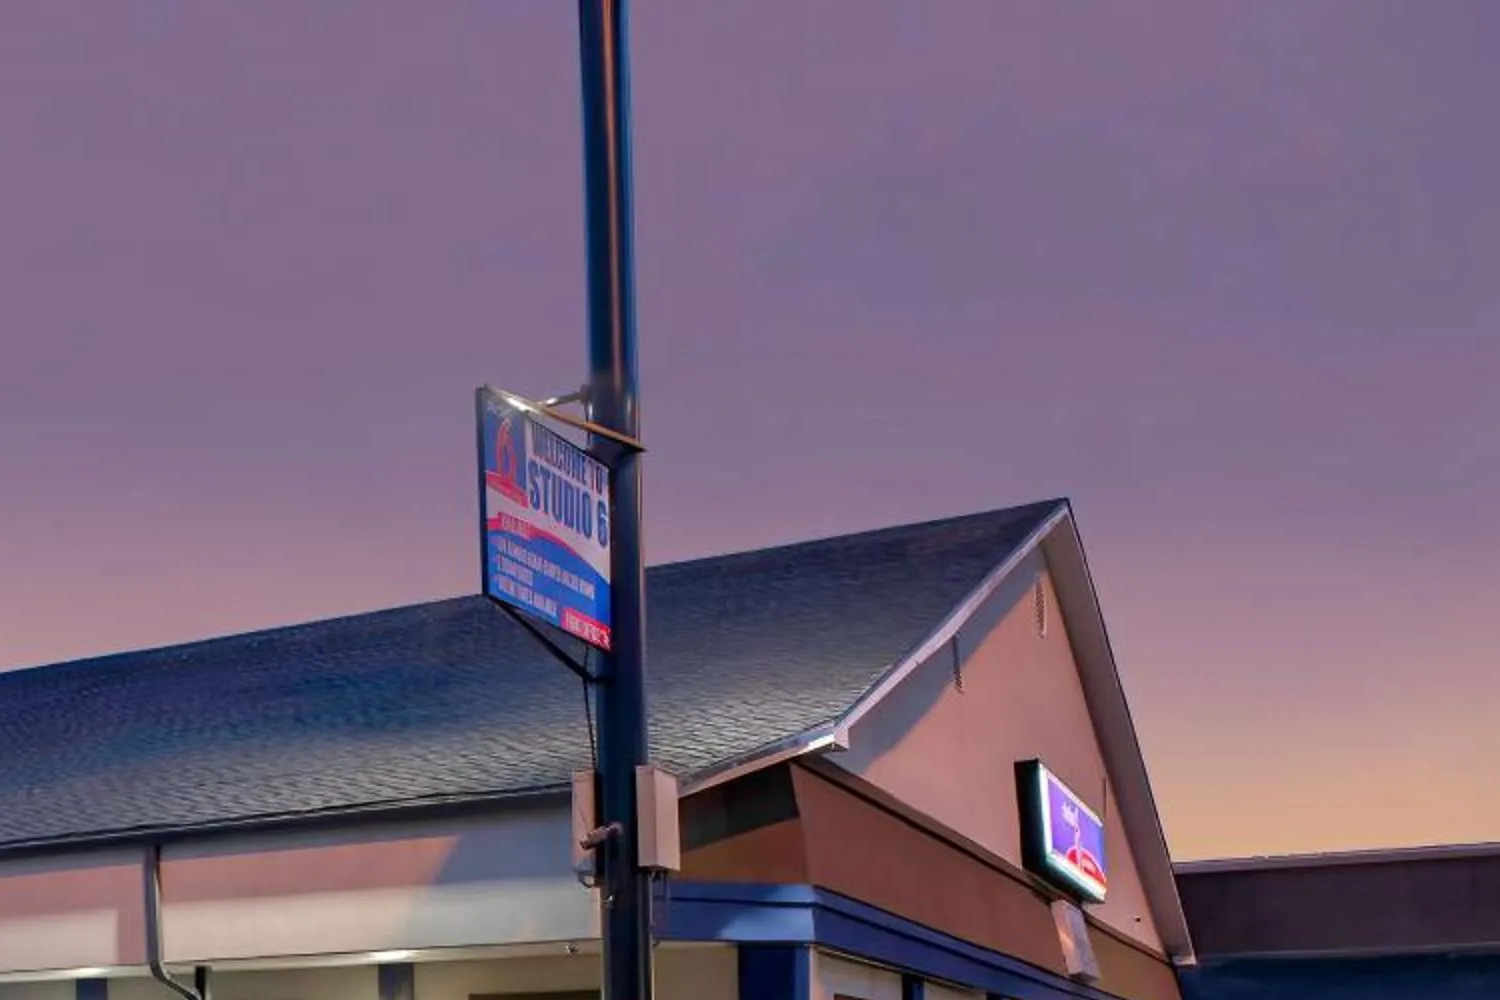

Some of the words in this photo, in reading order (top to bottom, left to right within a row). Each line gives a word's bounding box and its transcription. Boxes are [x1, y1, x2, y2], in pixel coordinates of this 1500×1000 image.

[531, 420, 587, 484] WELCOME
[588, 456, 605, 494] TO
[528, 460, 592, 540] STUDIO
[596, 500, 608, 548] 6
